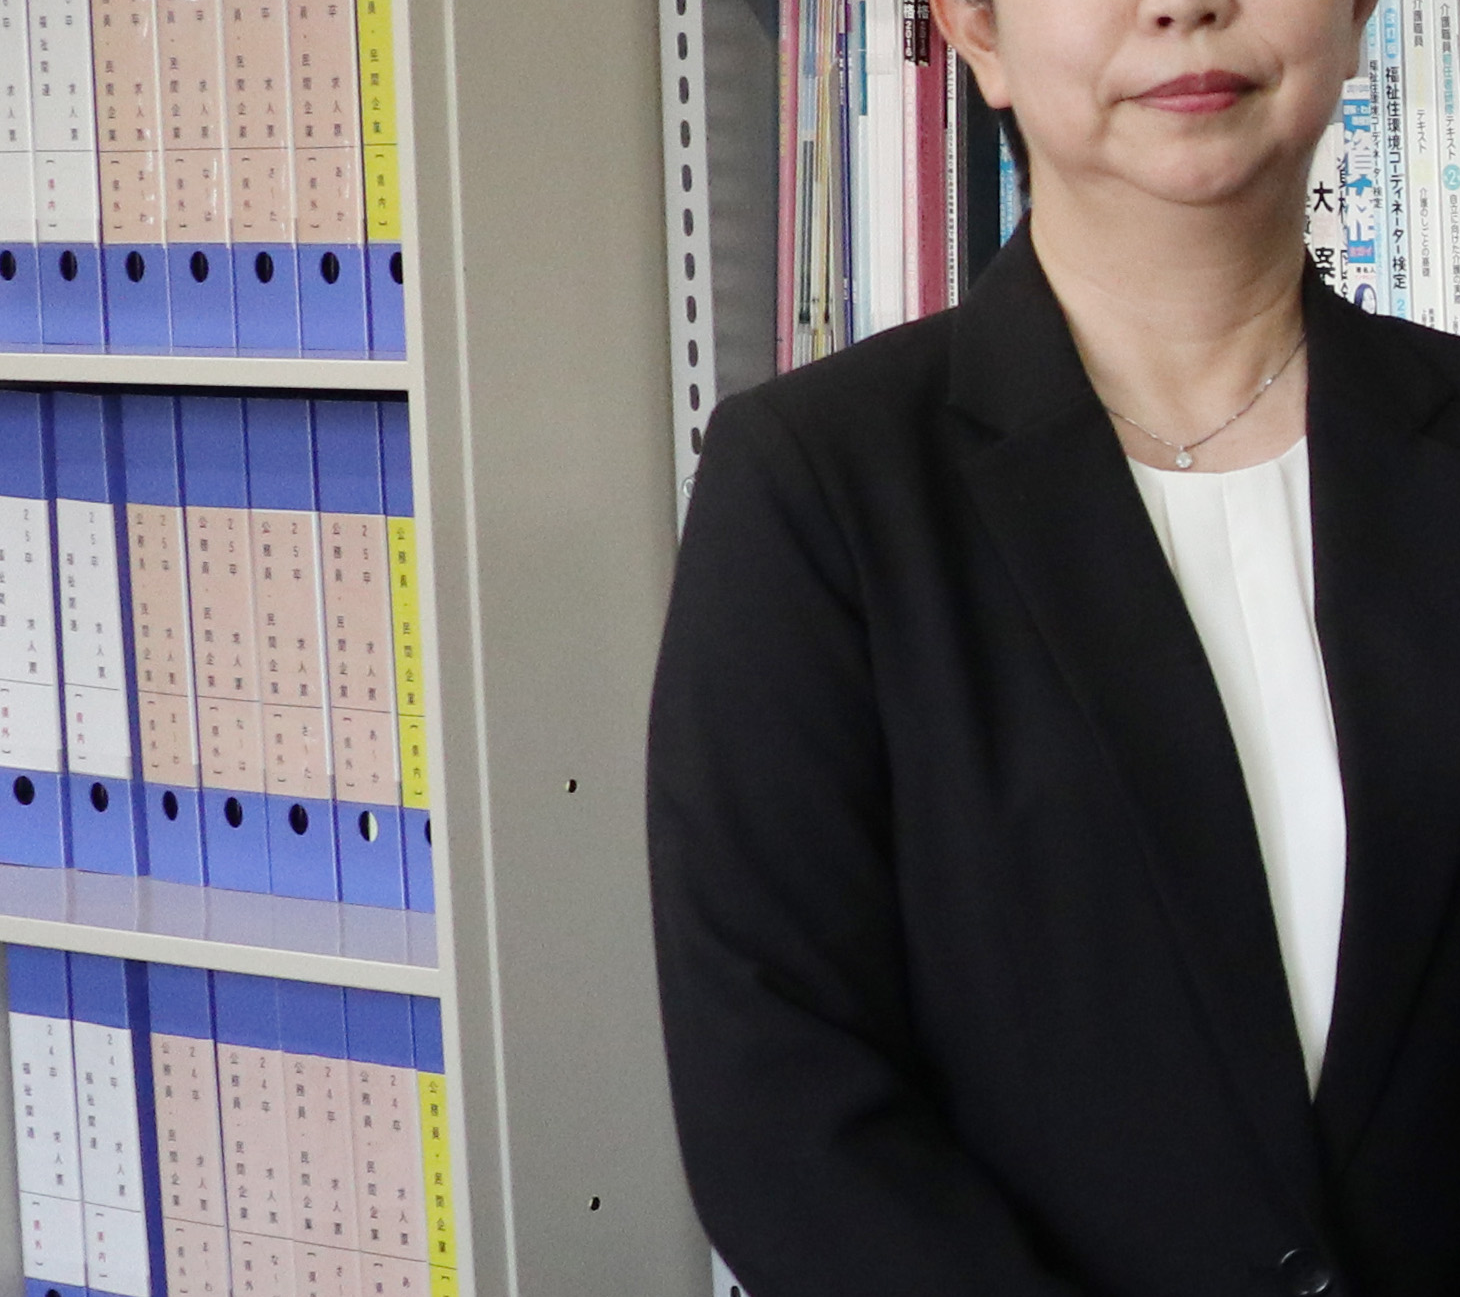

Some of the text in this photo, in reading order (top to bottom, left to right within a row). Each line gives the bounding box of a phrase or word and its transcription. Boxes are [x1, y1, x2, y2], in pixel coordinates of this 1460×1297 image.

[1385, 66, 1407, 289] 福祉住環境コーディネーター検定
[1416, 109, 1427, 153] テキスト
